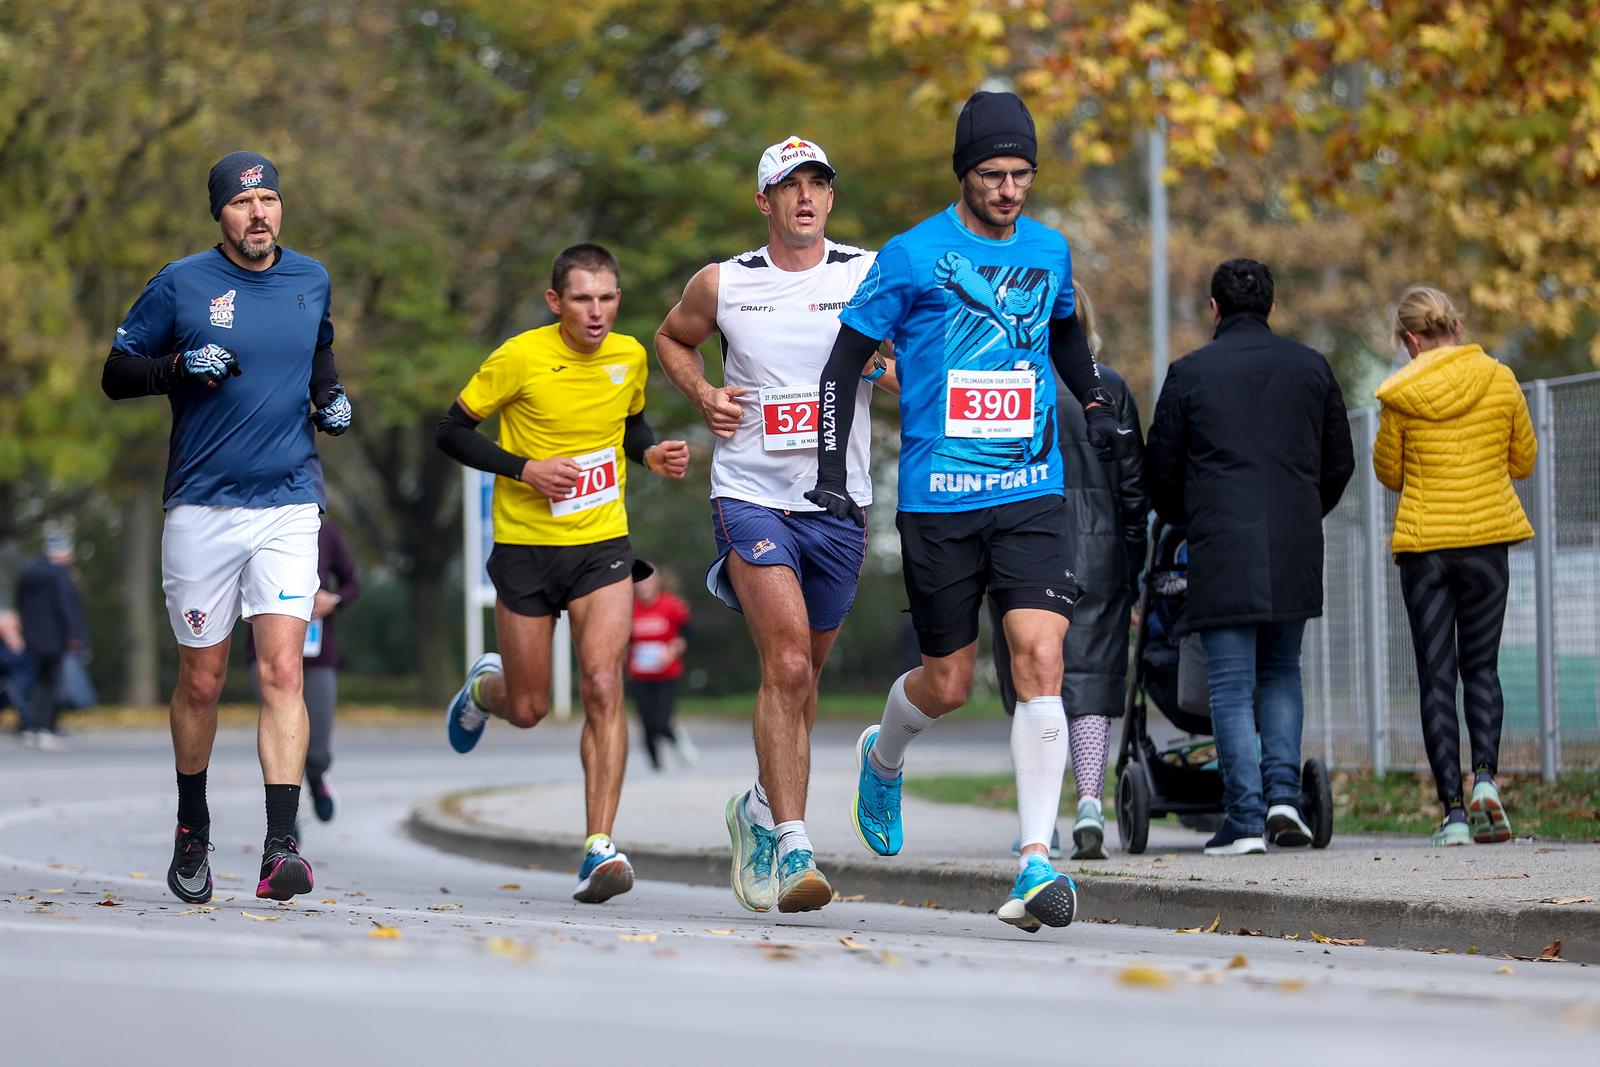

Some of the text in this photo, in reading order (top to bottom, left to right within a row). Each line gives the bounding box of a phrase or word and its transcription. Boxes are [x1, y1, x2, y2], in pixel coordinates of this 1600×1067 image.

[781, 150, 817, 164] Red Bull
[818, 301, 849, 312] SPARTA
[771, 392, 802, 401] POLUMARATON
[963, 389, 1021, 420] 390
[777, 403, 820, 433] 52
[823, 381, 838, 452] MAZATOR
[929, 463, 1050, 492] RUN FOR IT
